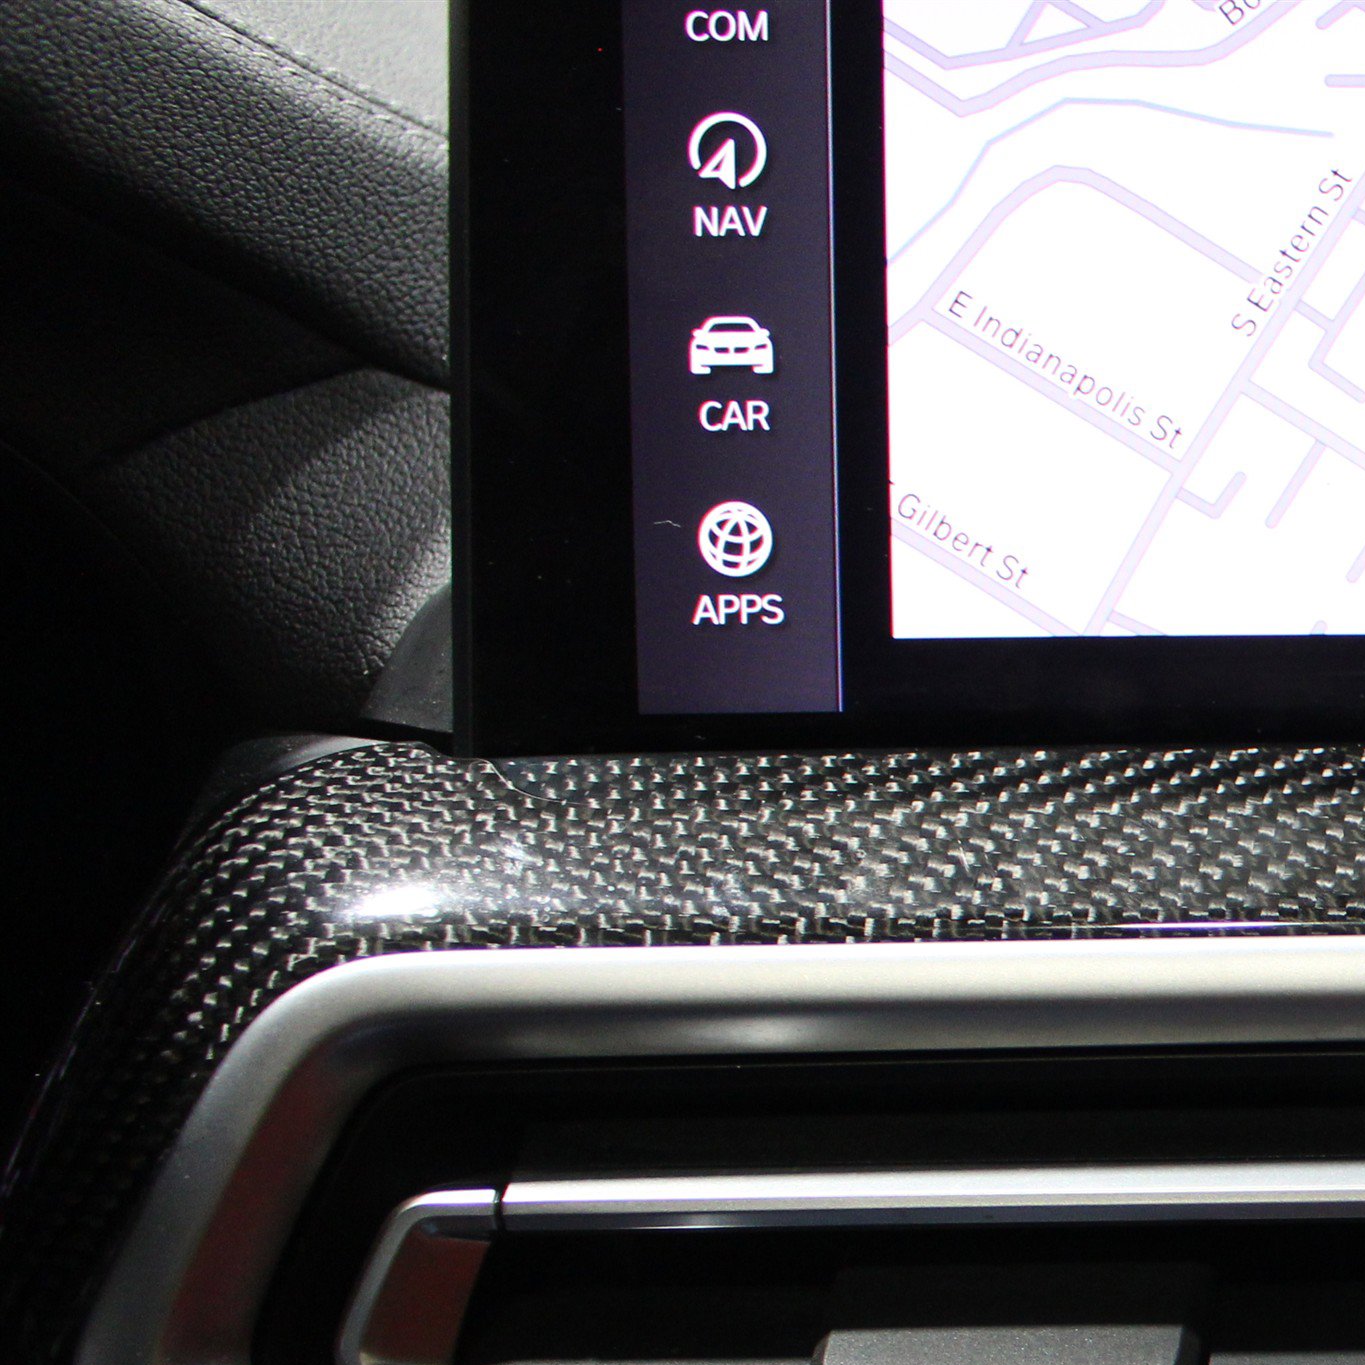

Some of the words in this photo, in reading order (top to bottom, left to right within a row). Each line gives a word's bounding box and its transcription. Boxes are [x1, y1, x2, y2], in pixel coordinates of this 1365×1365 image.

[685, 10, 769, 42] COM
[694, 205, 768, 237] NAV
[1231, 312, 1257, 338] S
[1247, 206, 1330, 315] Eastern
[1319, 167, 1353, 201] St
[948, 290, 974, 318] E
[973, 306, 1146, 428] Indianapolis
[1149, 415, 1183, 450] St
[699, 399, 771, 432] CAR
[898, 494, 993, 567] Gilbert
[996, 555, 1029, 588] St
[692, 593, 785, 626] APPS
